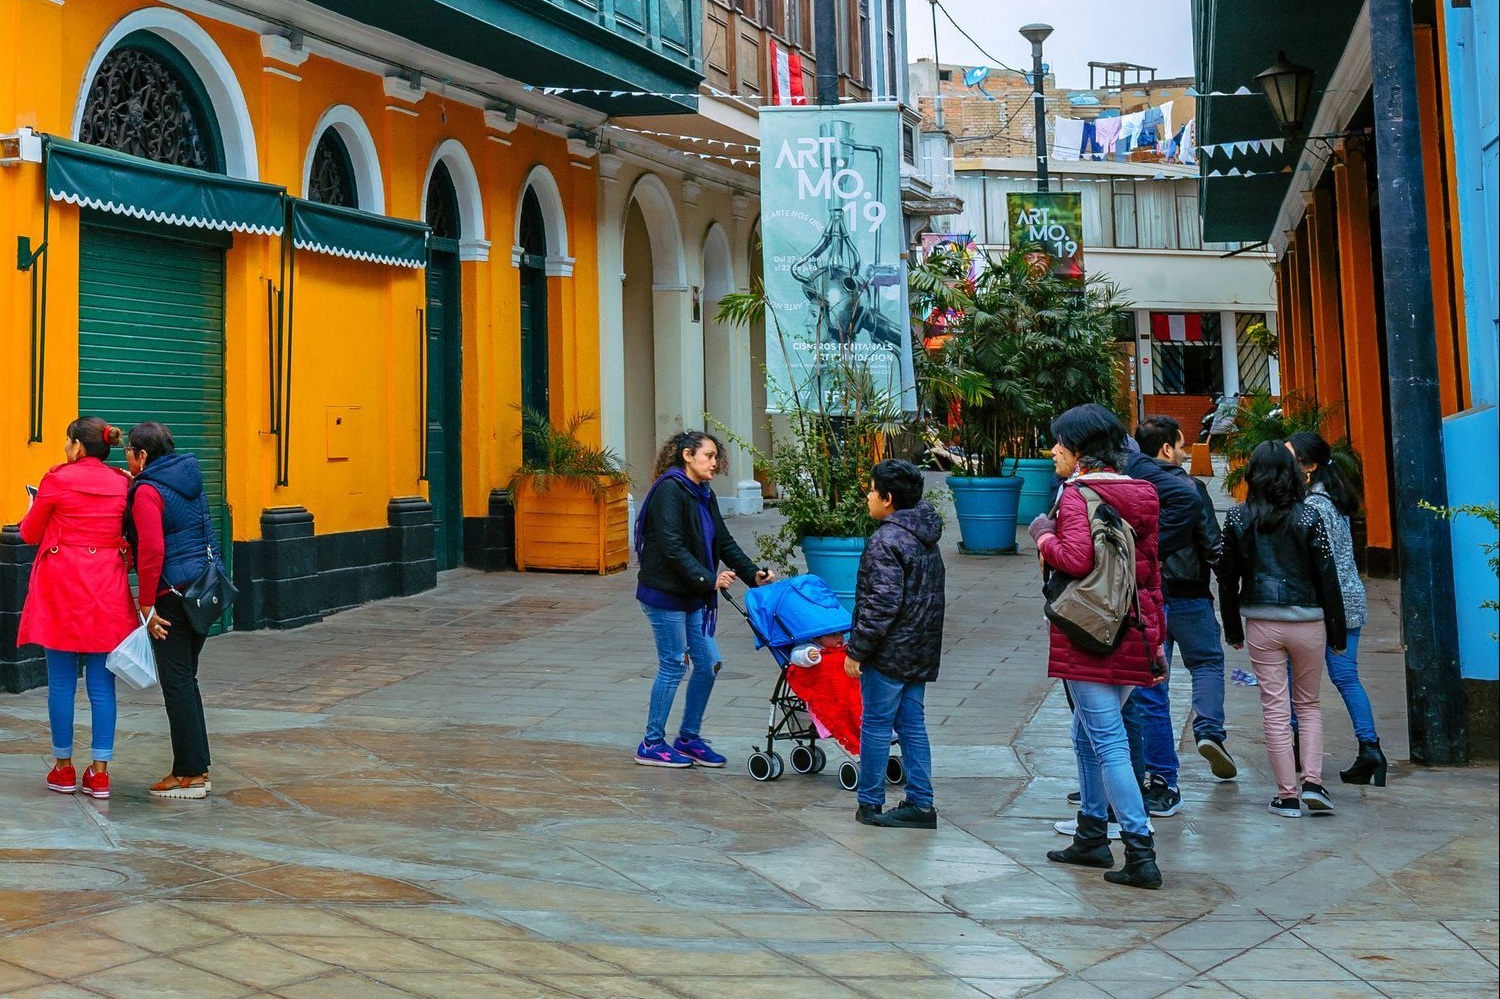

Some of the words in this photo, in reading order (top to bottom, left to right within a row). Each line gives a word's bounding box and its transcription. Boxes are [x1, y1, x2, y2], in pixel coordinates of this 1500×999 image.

[774, 137, 845, 168] ART.
[798, 169, 872, 200] MO.
[842, 201, 886, 232] 19
[1017, 208, 1055, 225] ART.
[1029, 224, 1070, 241] MO.
[1054, 241, 1078, 258] 19
